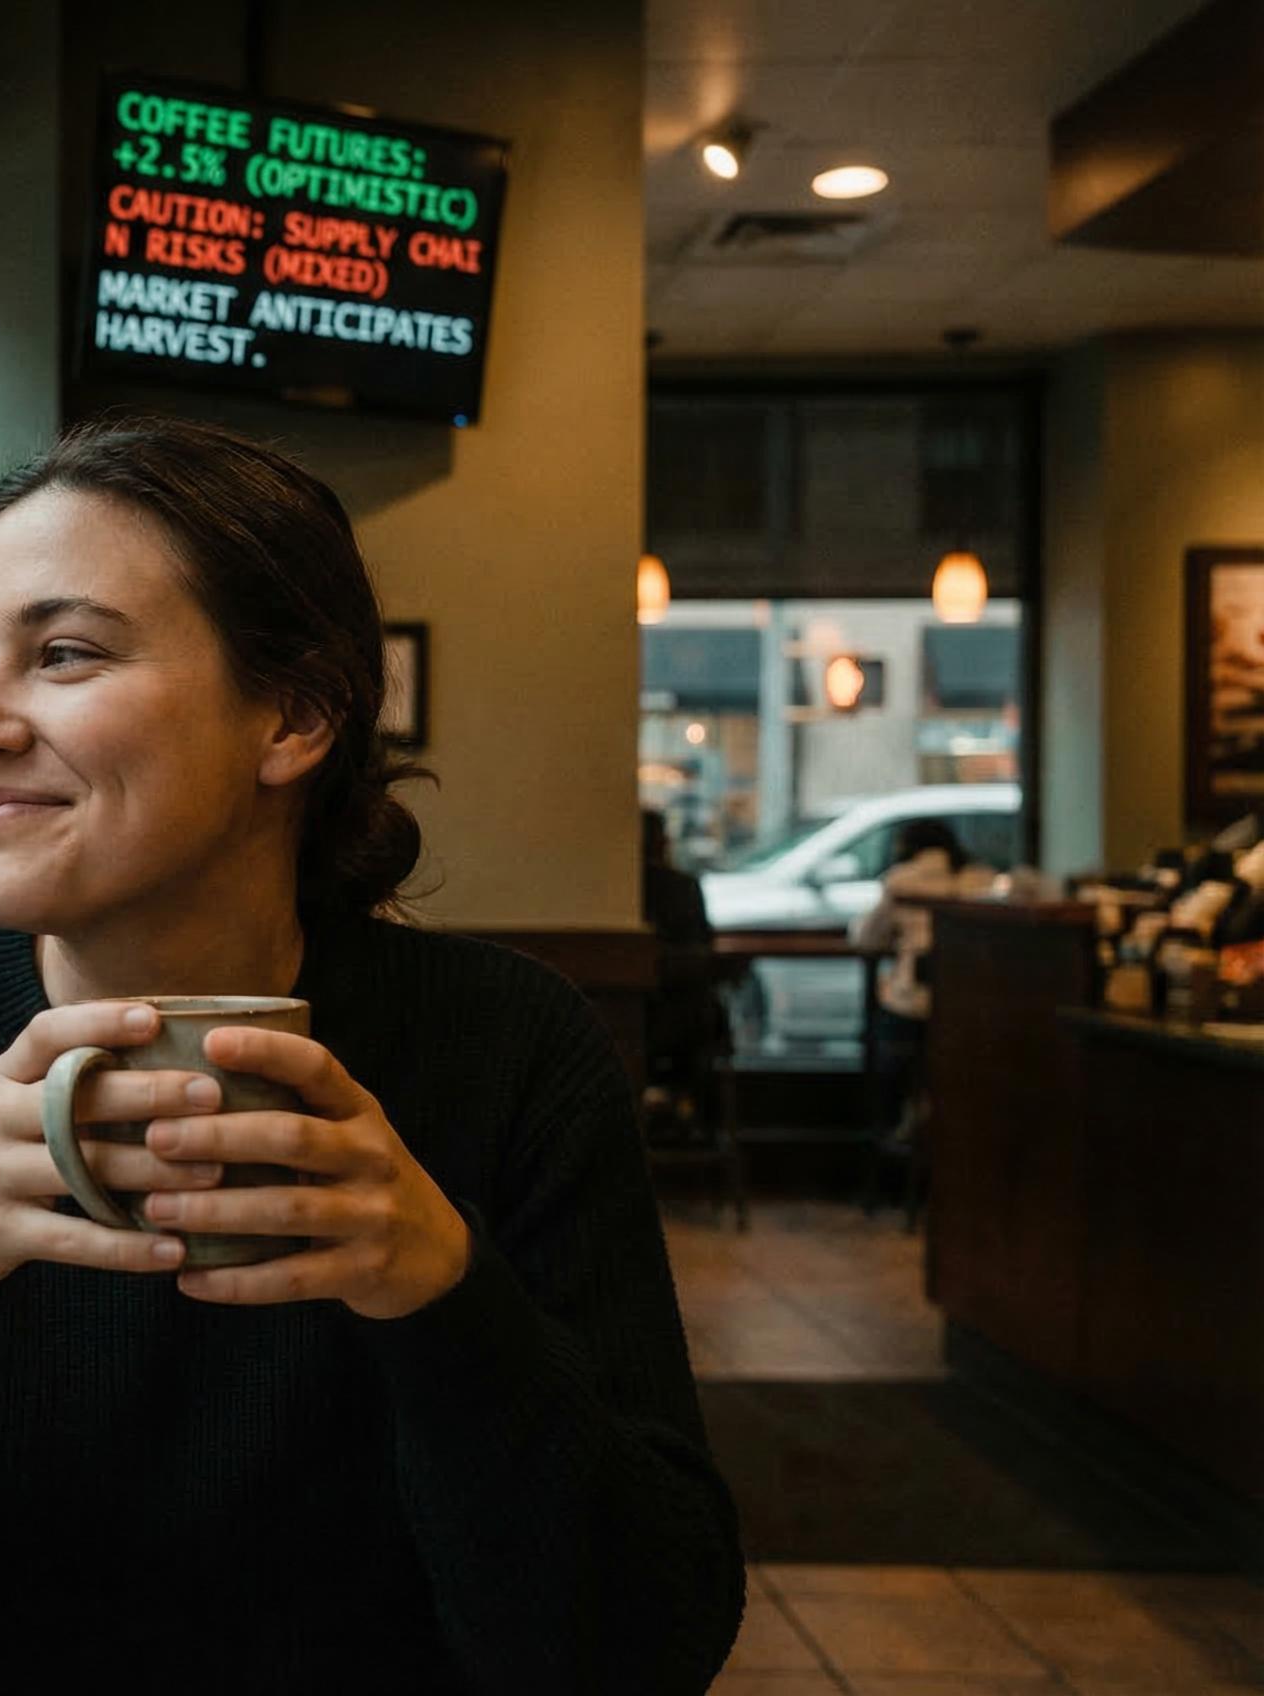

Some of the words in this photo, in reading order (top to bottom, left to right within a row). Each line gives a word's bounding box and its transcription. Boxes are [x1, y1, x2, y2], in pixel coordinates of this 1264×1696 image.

[118, 92, 251, 149] COFFEE
[269, 119, 426, 180] FUTURES:
[114, 136, 226, 186] +2.5%
[246, 154, 477, 231] (OPTIMISTIC)
[106, 223, 129, 257] N
[146, 228, 246, 275] RISKS
[264, 246, 389, 299] (MIXED)
[109, 186, 264, 239] CAUTION:
[285, 212, 397, 258] SUPPLY
[409, 233, 481, 273] CHAI
[96, 311, 266, 367] HARVEST.
[98, 271, 237, 322] MARKET
[249, 291, 473, 355] ANTICIPATES
